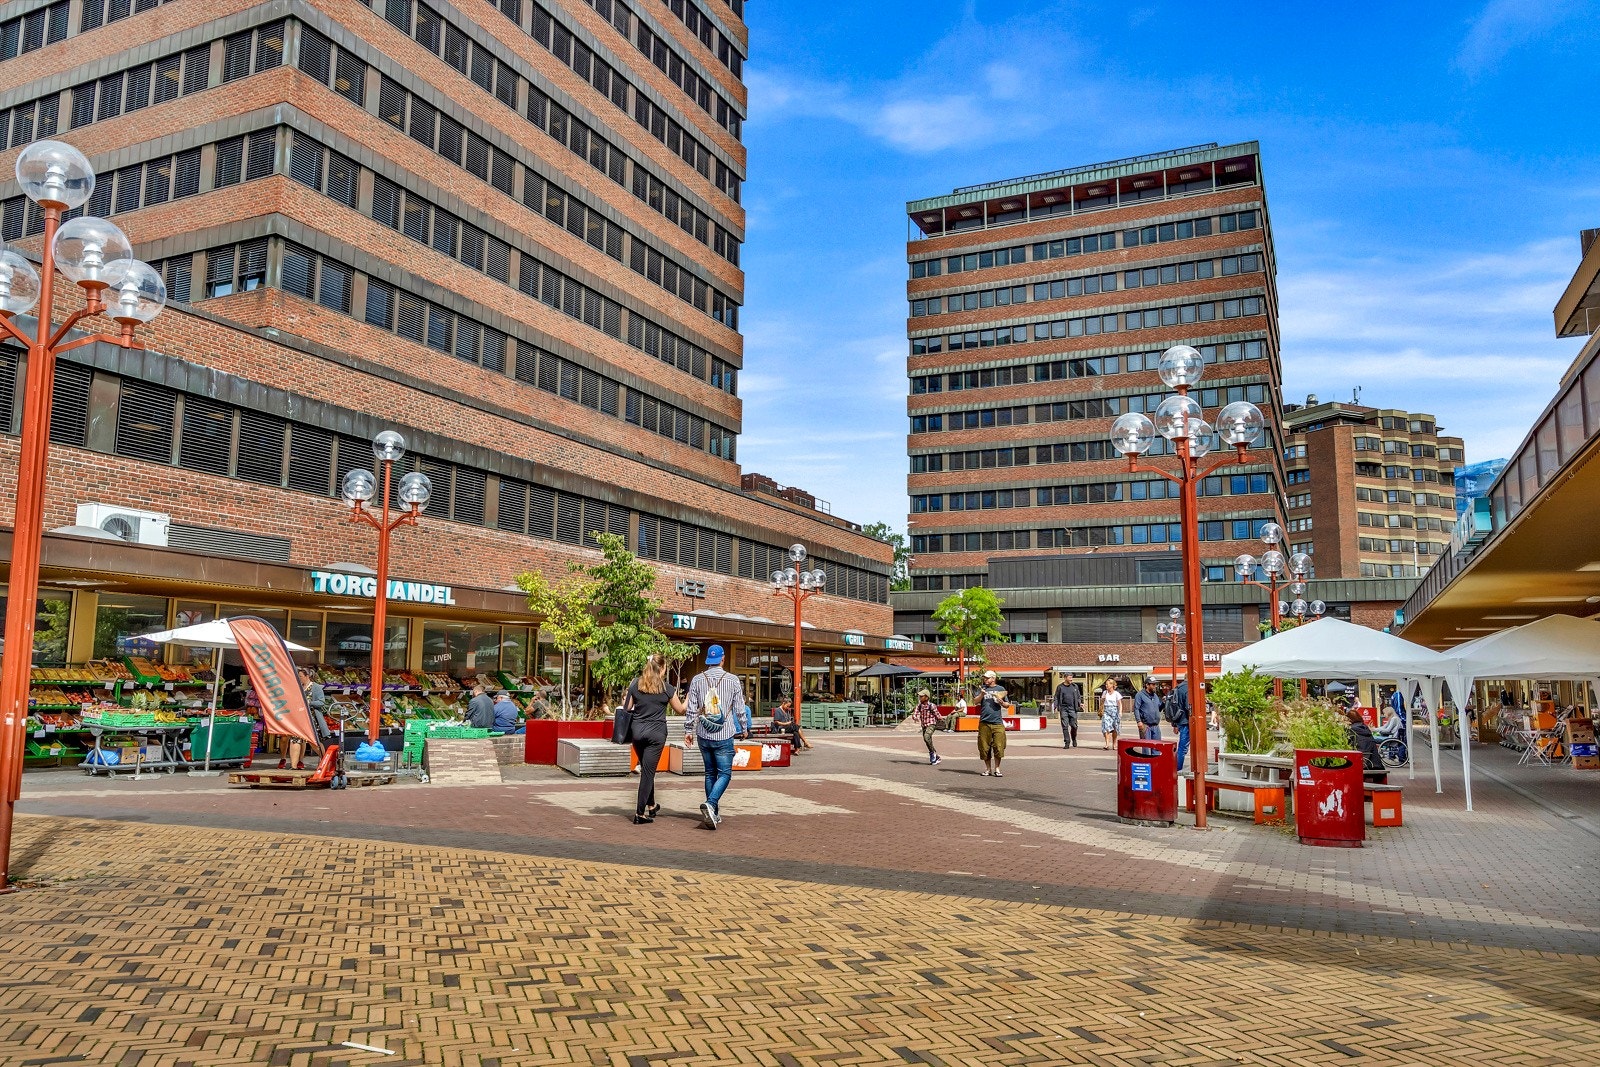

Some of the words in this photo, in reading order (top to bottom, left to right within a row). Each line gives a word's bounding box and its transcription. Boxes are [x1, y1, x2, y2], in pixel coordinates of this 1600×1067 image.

[311, 571, 456, 605] TORGANDEL
[674, 614, 697, 630] TSV
[846, 634, 865, 646] GRILL
[1098, 654, 1120, 662] BAR
[1181, 653, 1220, 661] BERI
